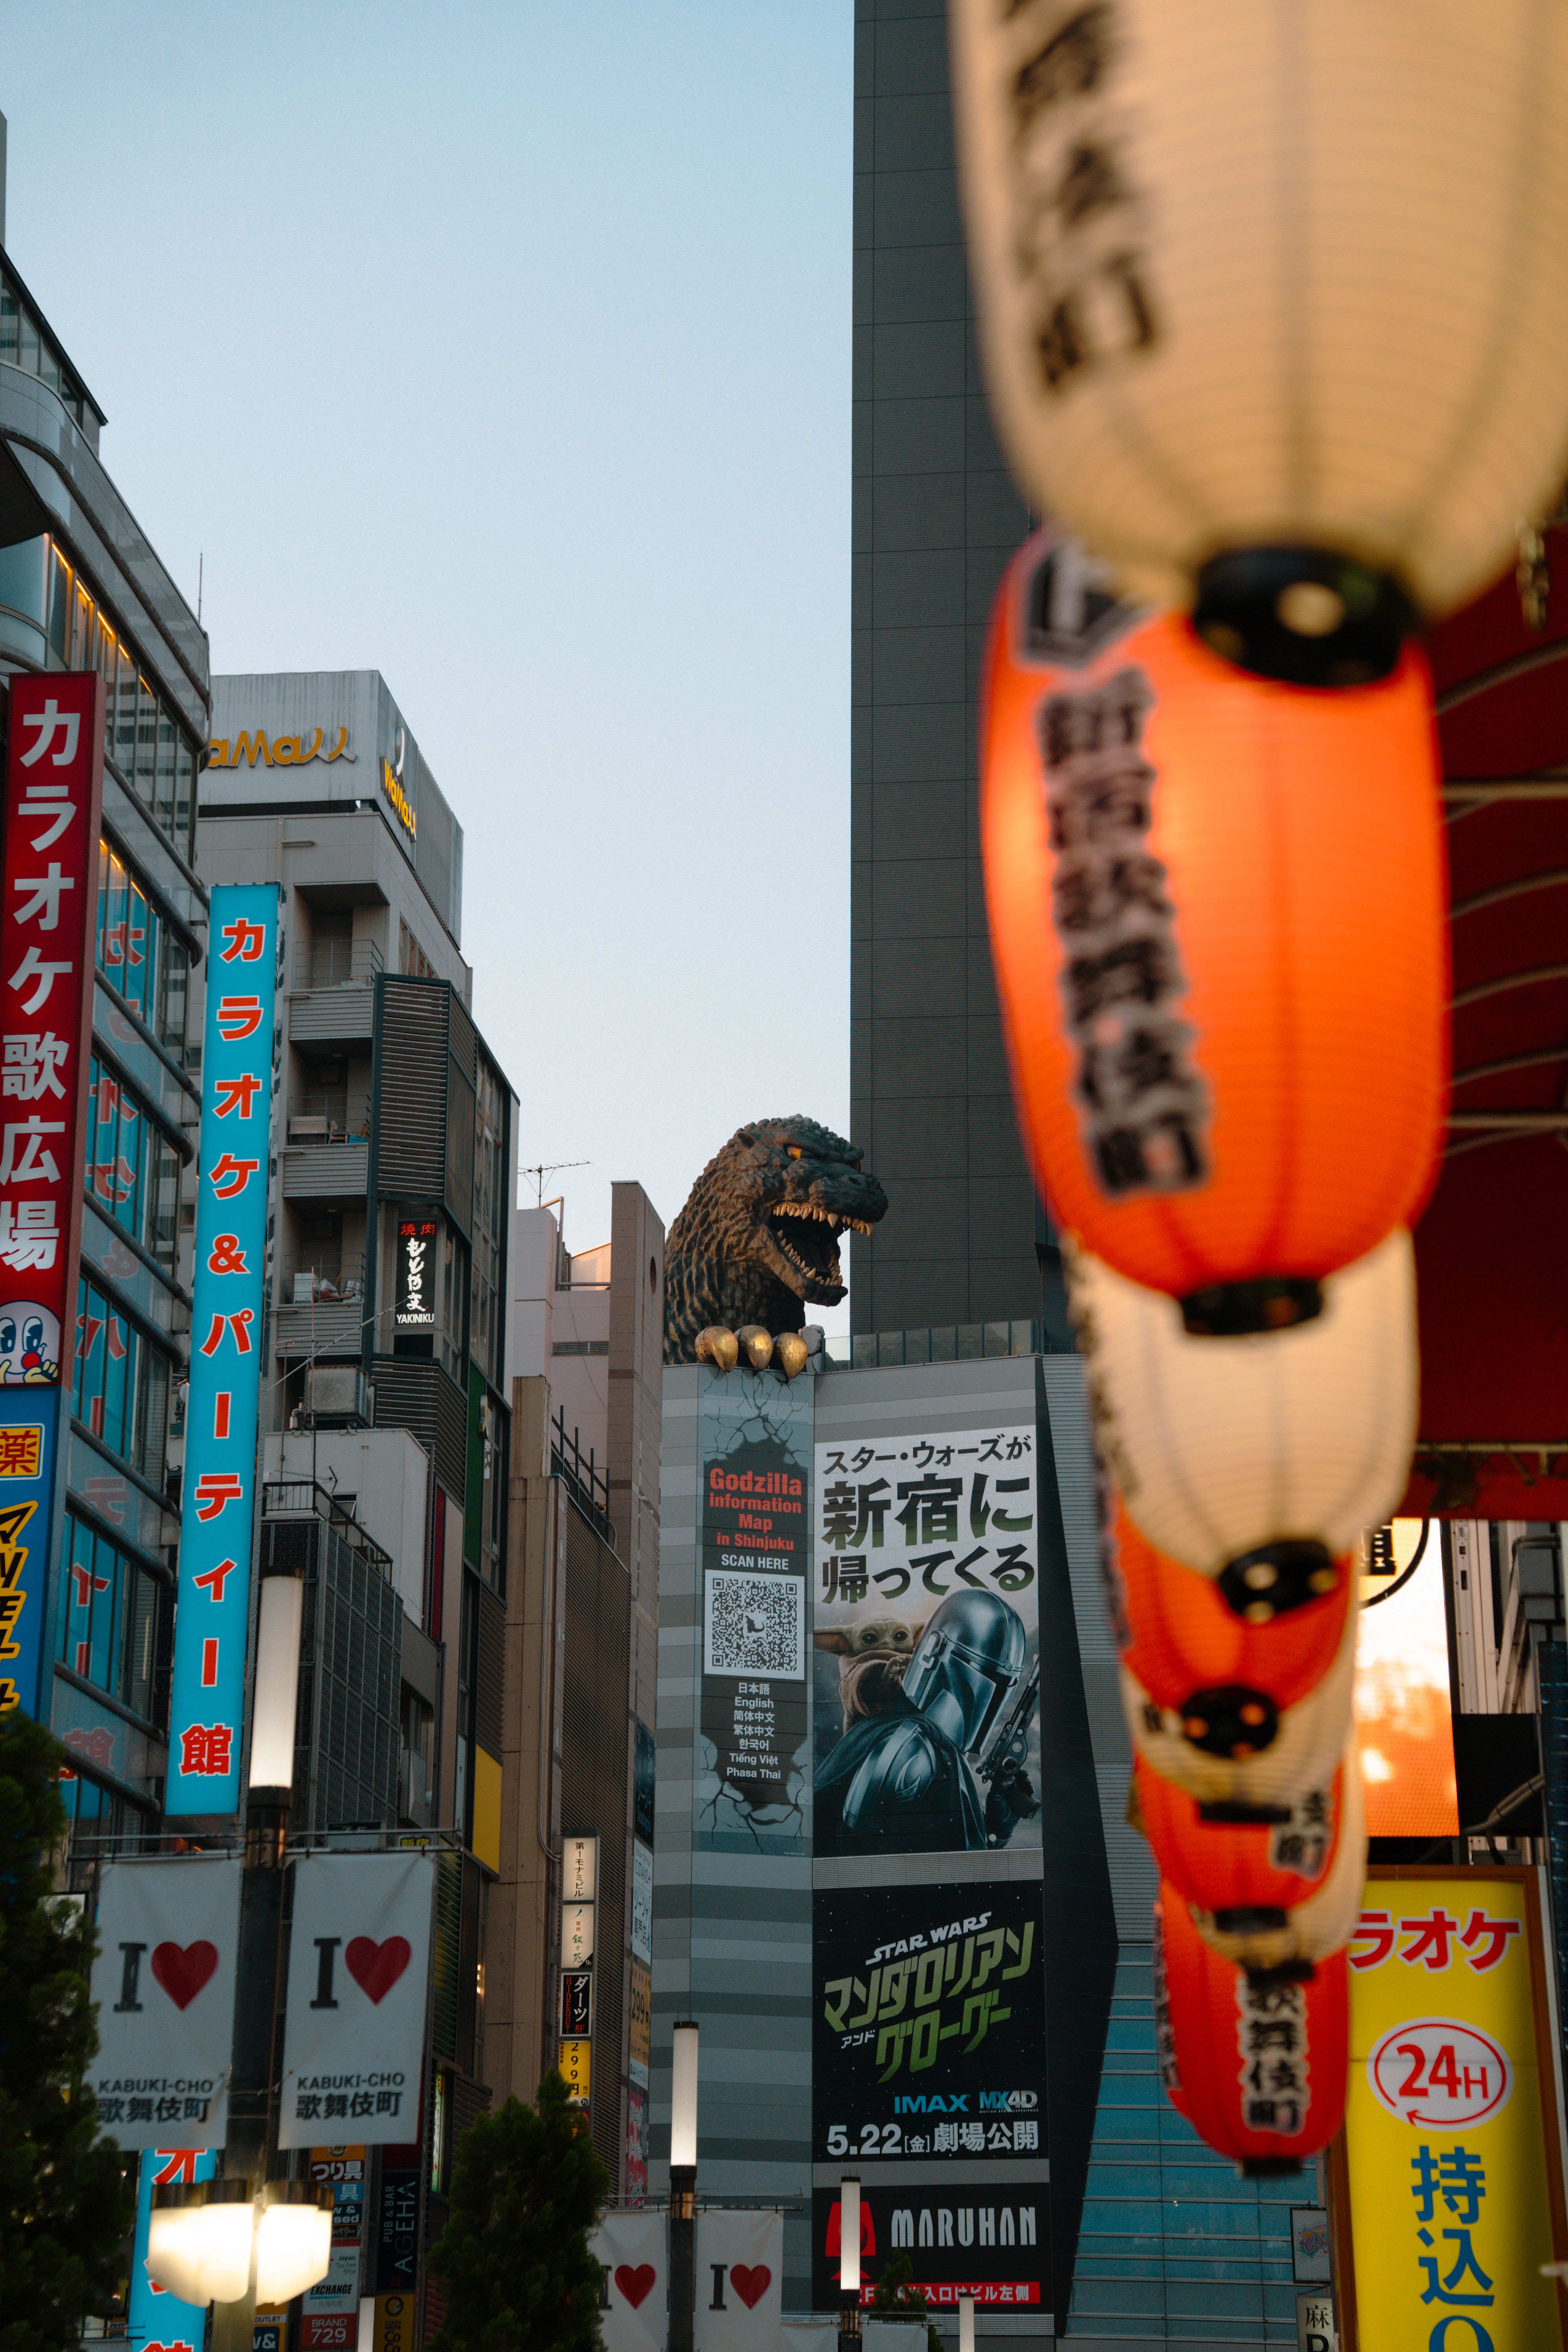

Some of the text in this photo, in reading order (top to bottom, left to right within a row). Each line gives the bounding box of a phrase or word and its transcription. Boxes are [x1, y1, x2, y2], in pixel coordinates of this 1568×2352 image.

[0, 699, 80, 1270] カラオケ歌広場
[400, 1223, 435, 1235] 焼肉
[396, 1313, 434, 1324] YAKINIKU
[178, 918, 266, 1776] カラオケ&パーティー館
[823, 1433, 1031, 1475] スター・ウォーズが
[709, 1467, 802, 1496] Godzilla
[709, 1493, 802, 1514] Information
[821, 1472, 1034, 1550] 新宿に
[738, 1515, 772, 1533] Map
[717, 1533, 794, 1552] in Shinjuku
[722, 1554, 789, 1570] SCAN HERE
[822, 1544, 1036, 1604] 帰ってくる
[738, 1683, 770, 1696] 日本語
[734, 1696, 774, 1710] English
[734, 1710, 775, 1723] 简体中文
[734, 1724, 774, 1738] 繁体中文
[739, 1738, 769, 1751] 한국어
[730, 1752, 778, 1768] Tiếng Việt
[727, 1767, 781, 1779] Phasa Thai
[574, 1842, 585, 1897] 第1モナミビル
[866, 1912, 992, 1965] STAR WARS
[1350, 1908, 1520, 1972] ラオケ
[114, 1943, 147, 2012] I
[310, 1938, 341, 2009] I
[824, 1921, 1035, 2032] マンダロリアン
[574, 1976, 589, 2022] ダーツ
[575, 2024, 585, 2033] 8F
[876, 1989, 1012, 2084] グローグー
[841, 2030, 875, 2049] アンド
[297, 2071, 405, 2091] KABUKI-CHO
[1397, 2045, 1488, 2098] 24H
[99, 2079, 213, 2093] KABUKI-CHO
[97, 2097, 211, 2122] 歌舞伎町
[297, 2090, 402, 2119] 歌舞伎町
[895, 2095, 969, 2114] IMAX
[979, 2090, 1038, 2112] MX4D
[312, 2161, 362, 2181] つり具
[334, 2214, 359, 2224] sed
[383, 2185, 394, 2242] PUB & BAR
[394, 2181, 415, 2273] AGEHA
[891, 2207, 1037, 2248] MARUHAN
[310, 2284, 352, 2295] EXCHANGE
[709, 2264, 728, 2310] I
[312, 2318, 347, 2327] BRAND
[1306, 2304, 1333, 2329] 麻
[311, 2328, 347, 2344] 729
